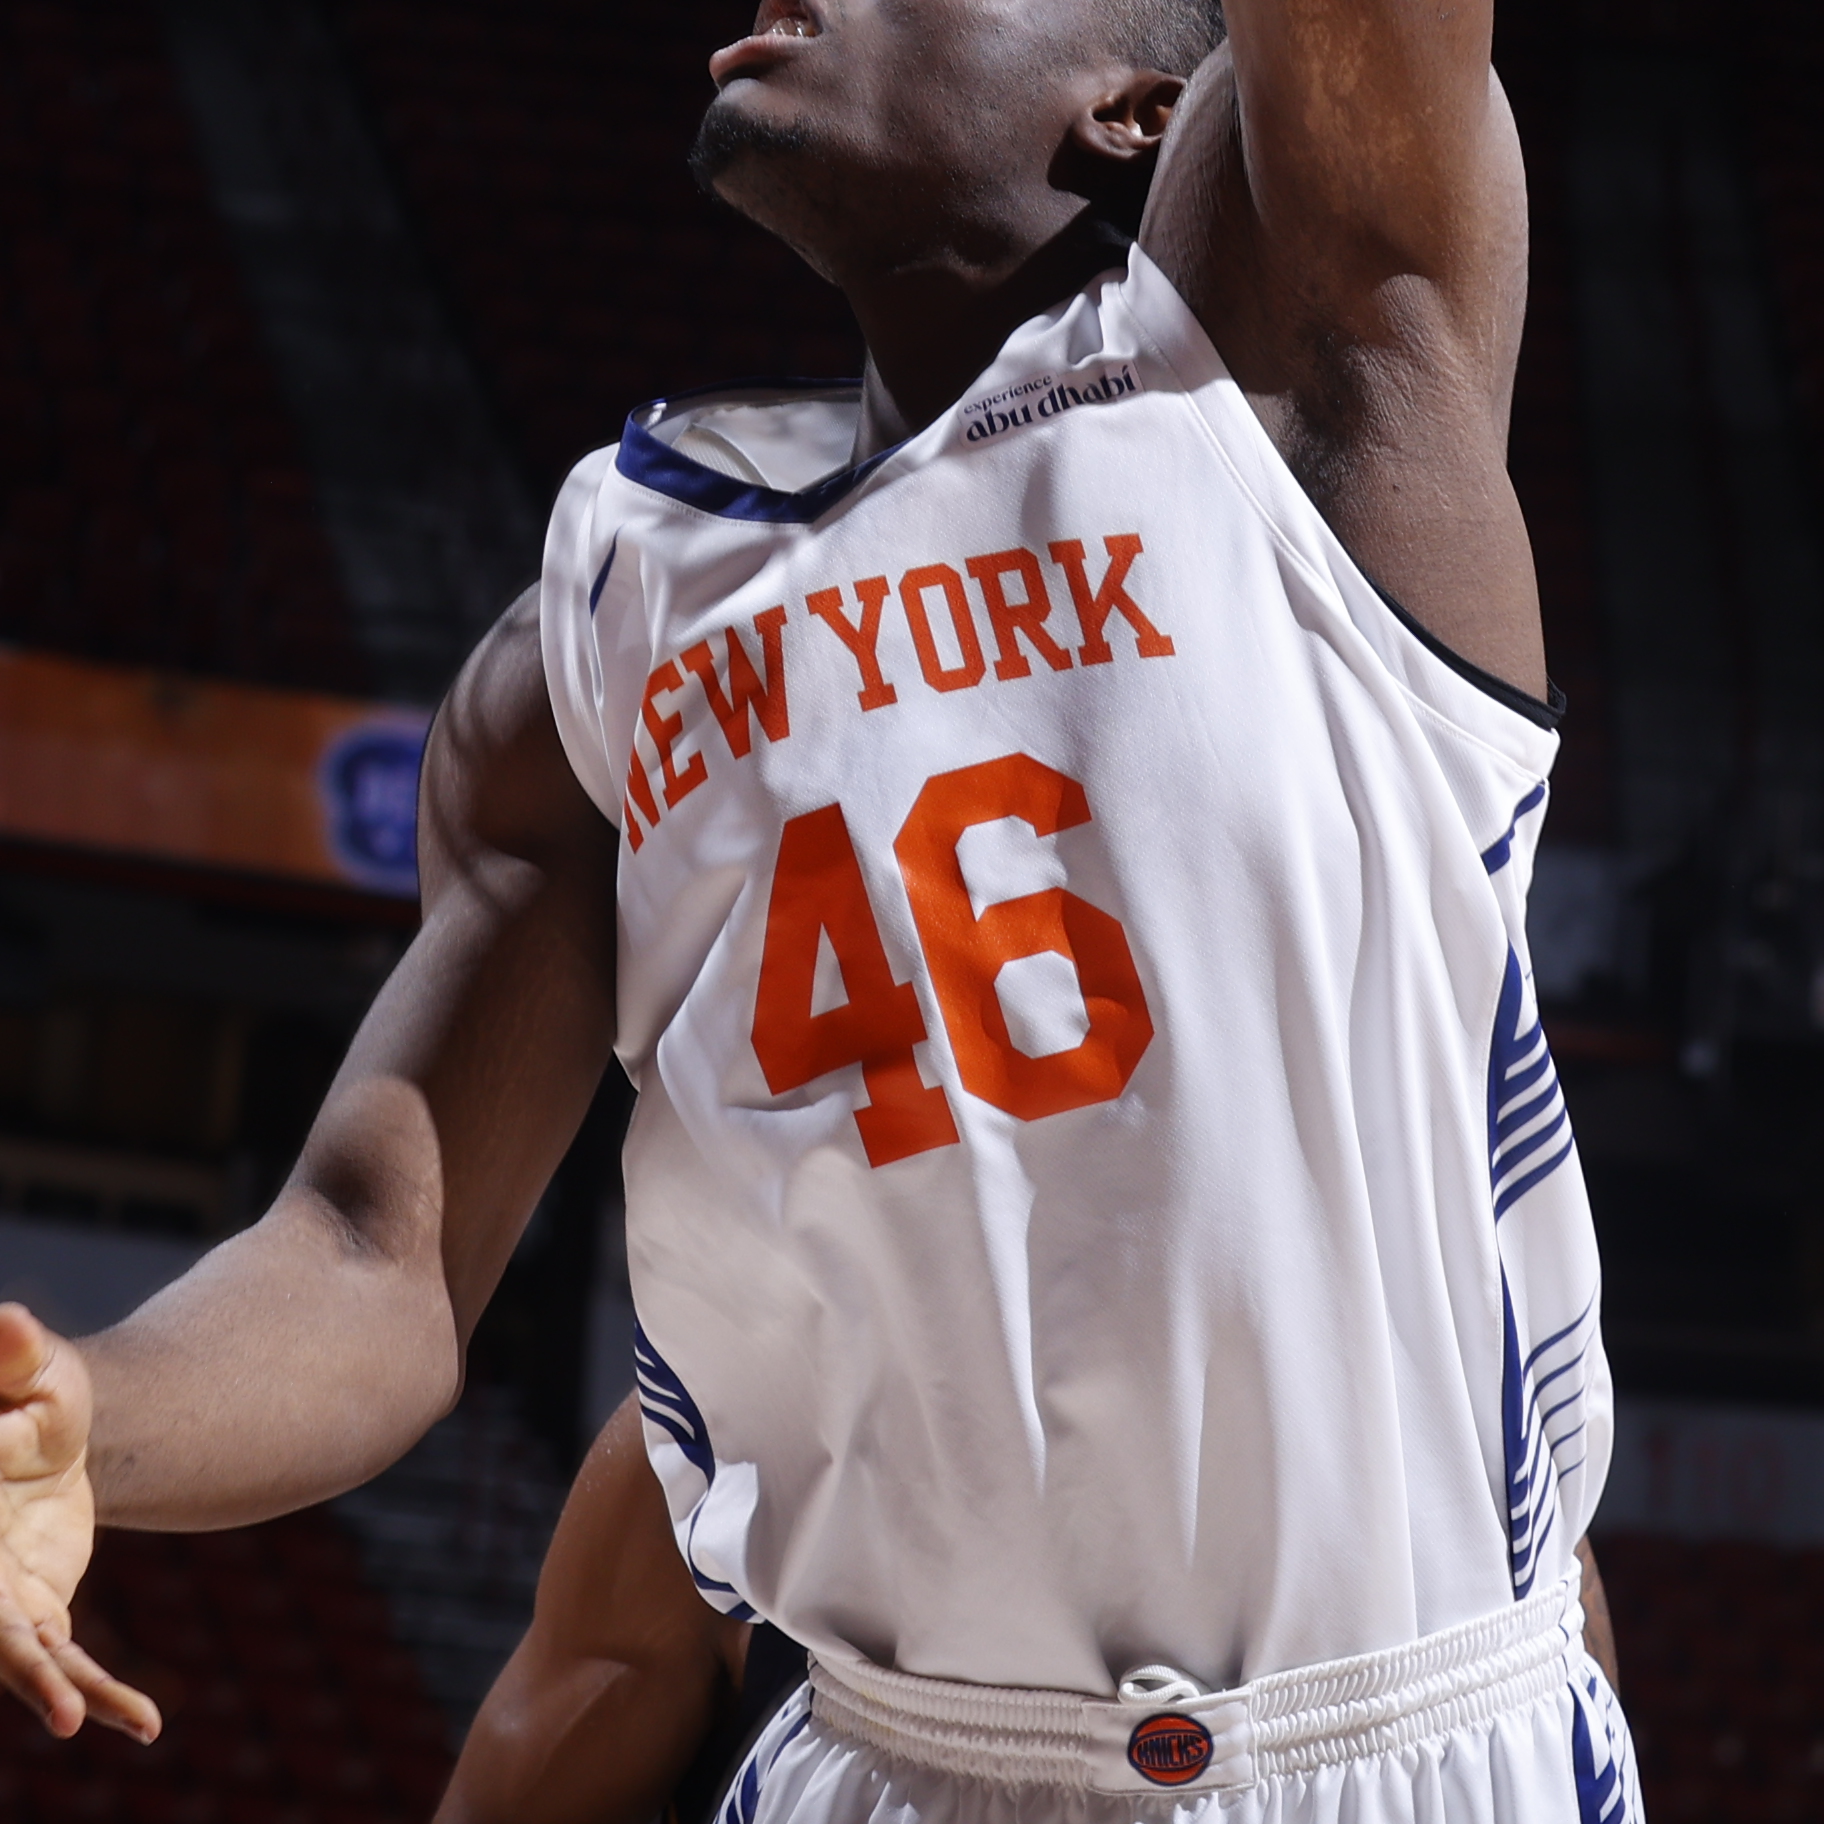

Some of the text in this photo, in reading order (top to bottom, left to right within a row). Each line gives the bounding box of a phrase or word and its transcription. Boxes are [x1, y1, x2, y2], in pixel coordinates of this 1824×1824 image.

[963, 374, 1053, 415] experience
[966, 405, 1033, 442] abu
[622, 532, 1176, 855] NEW YORK
[750, 751, 1155, 1169] 46
